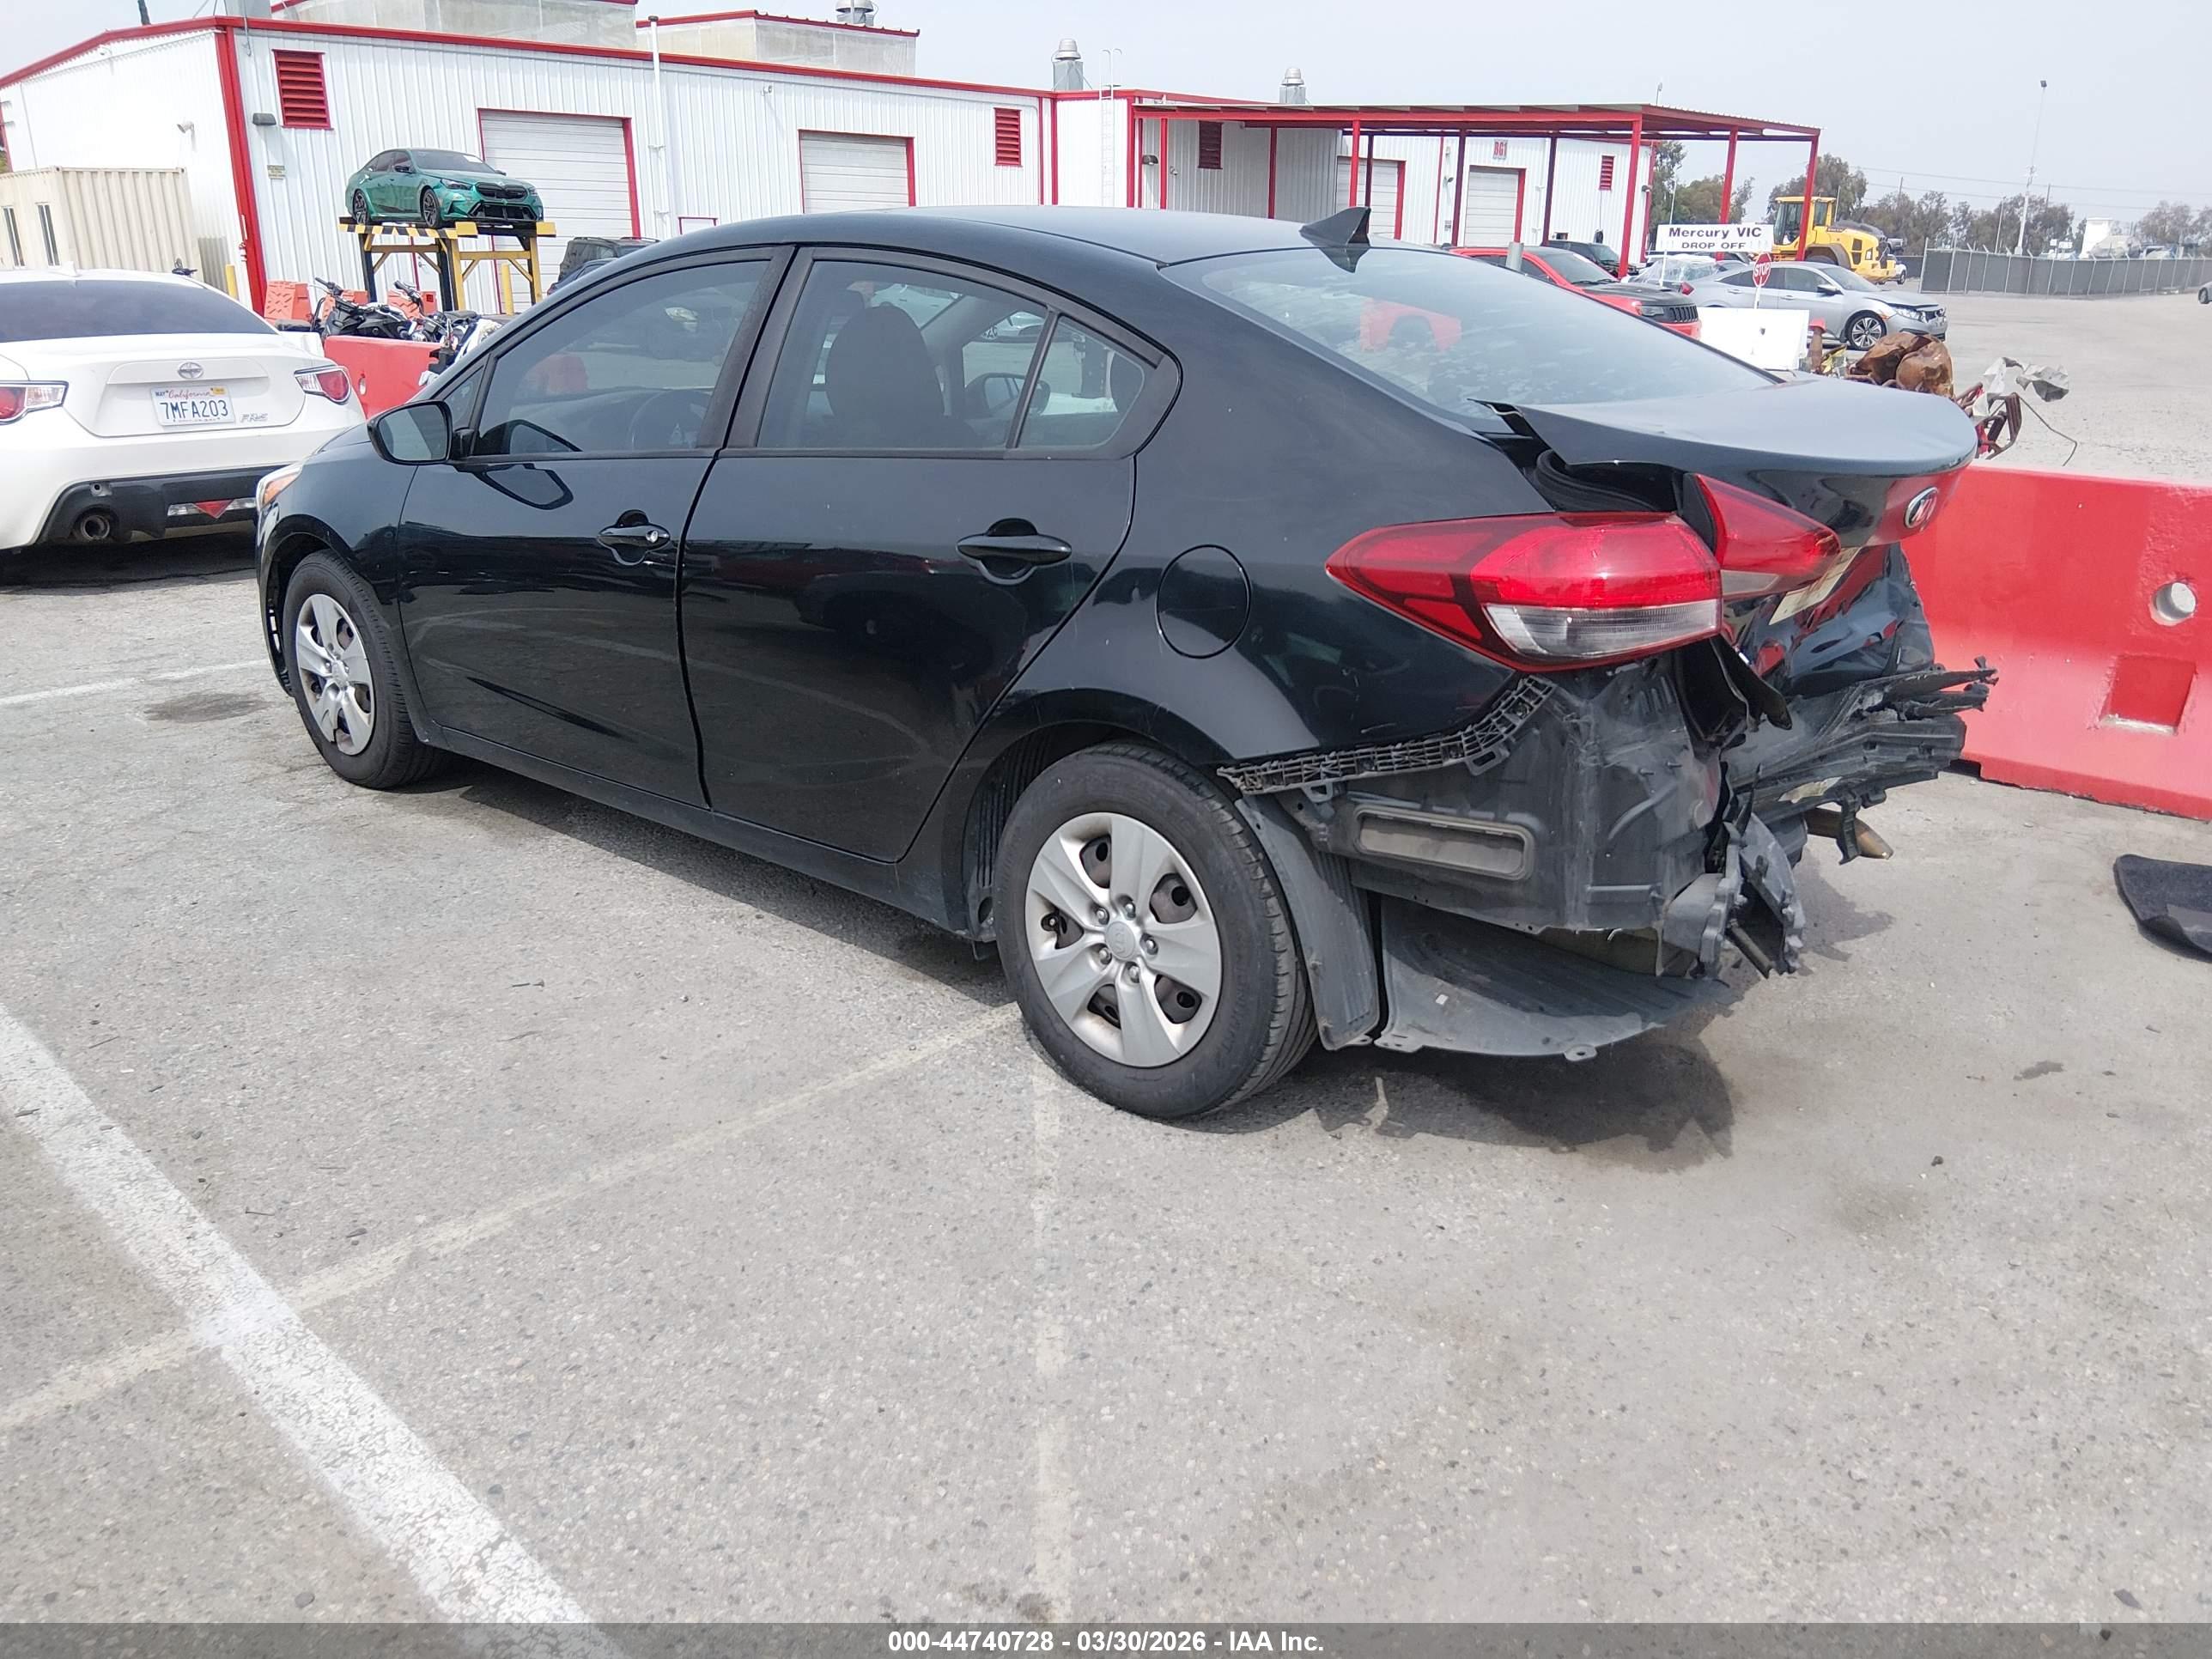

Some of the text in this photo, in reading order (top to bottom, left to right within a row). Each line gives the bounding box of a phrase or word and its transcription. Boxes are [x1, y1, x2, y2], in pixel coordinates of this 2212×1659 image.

[1668, 227, 1762, 239] Mercury VIC
[1754, 262, 1770, 276] STOP
[160, 400, 228, 419] 7MFA203
